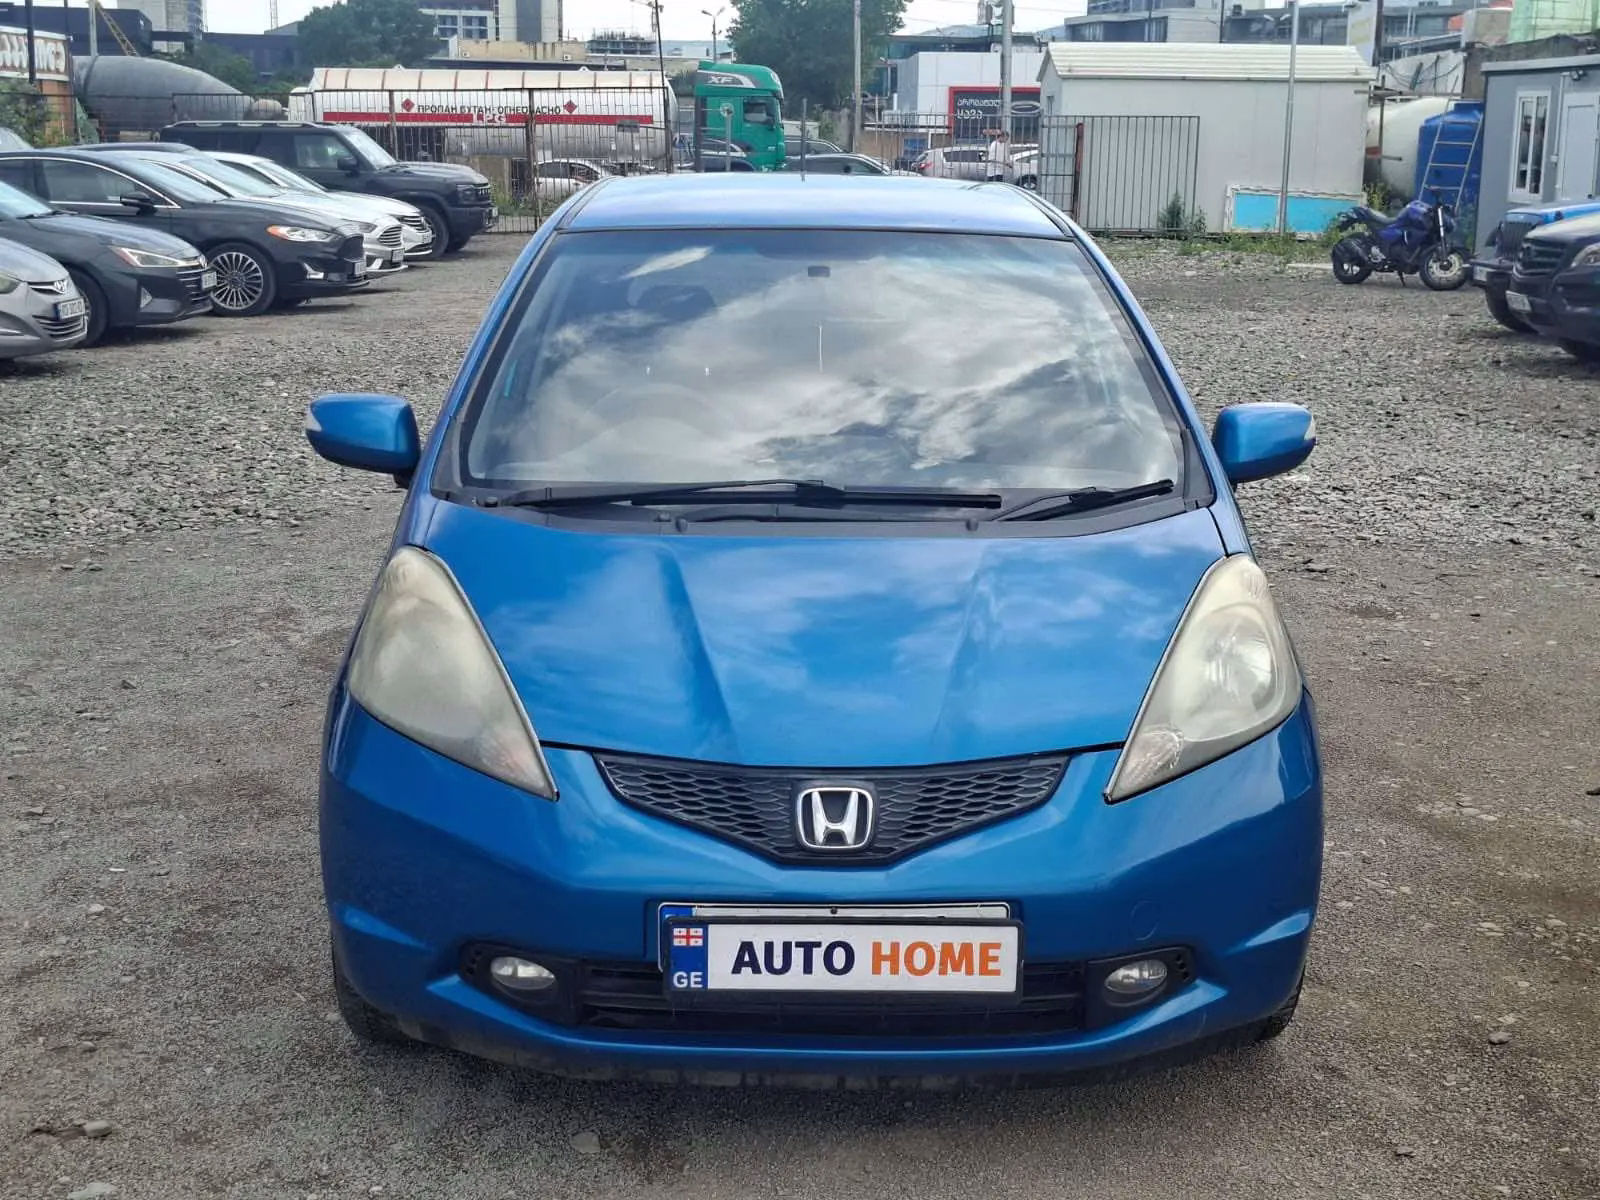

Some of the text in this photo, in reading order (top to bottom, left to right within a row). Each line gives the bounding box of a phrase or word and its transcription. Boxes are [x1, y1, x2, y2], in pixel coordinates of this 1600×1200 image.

[708, 75, 734, 84] XF
[417, 104, 458, 113] ПРОПАН
[498, 105, 561, 115] ОГНЕОАСНО
[731, 941, 1002, 976] AUTO HOME
[673, 971, 704, 988] GE
